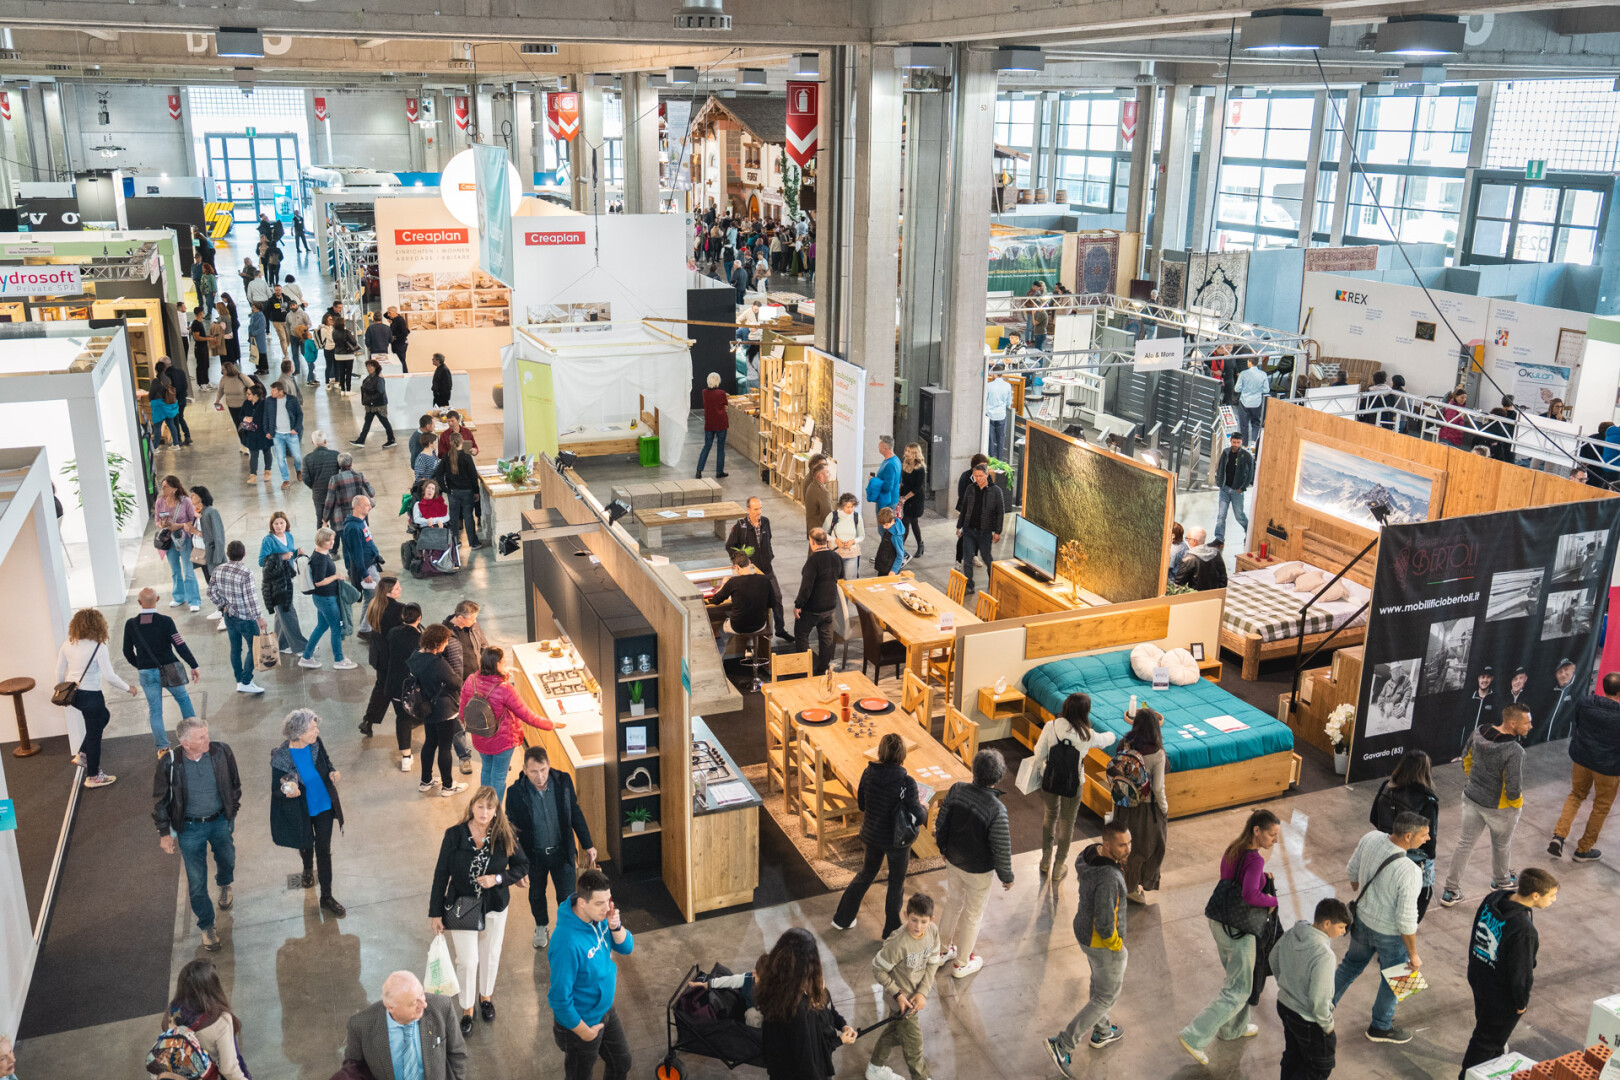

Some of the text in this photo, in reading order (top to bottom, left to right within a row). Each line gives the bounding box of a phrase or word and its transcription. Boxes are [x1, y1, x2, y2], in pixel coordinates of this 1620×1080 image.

[402, 230, 461, 243] Creaplan
[531, 233, 580, 244] Creaplan
[1347, 291, 1368, 305] REX
[1412, 542, 1479, 576] BERTOLI
[1379, 591, 1480, 615] www.mobilificiobertoli.it
[1363, 746, 1404, 761] Gavardo (BS)
